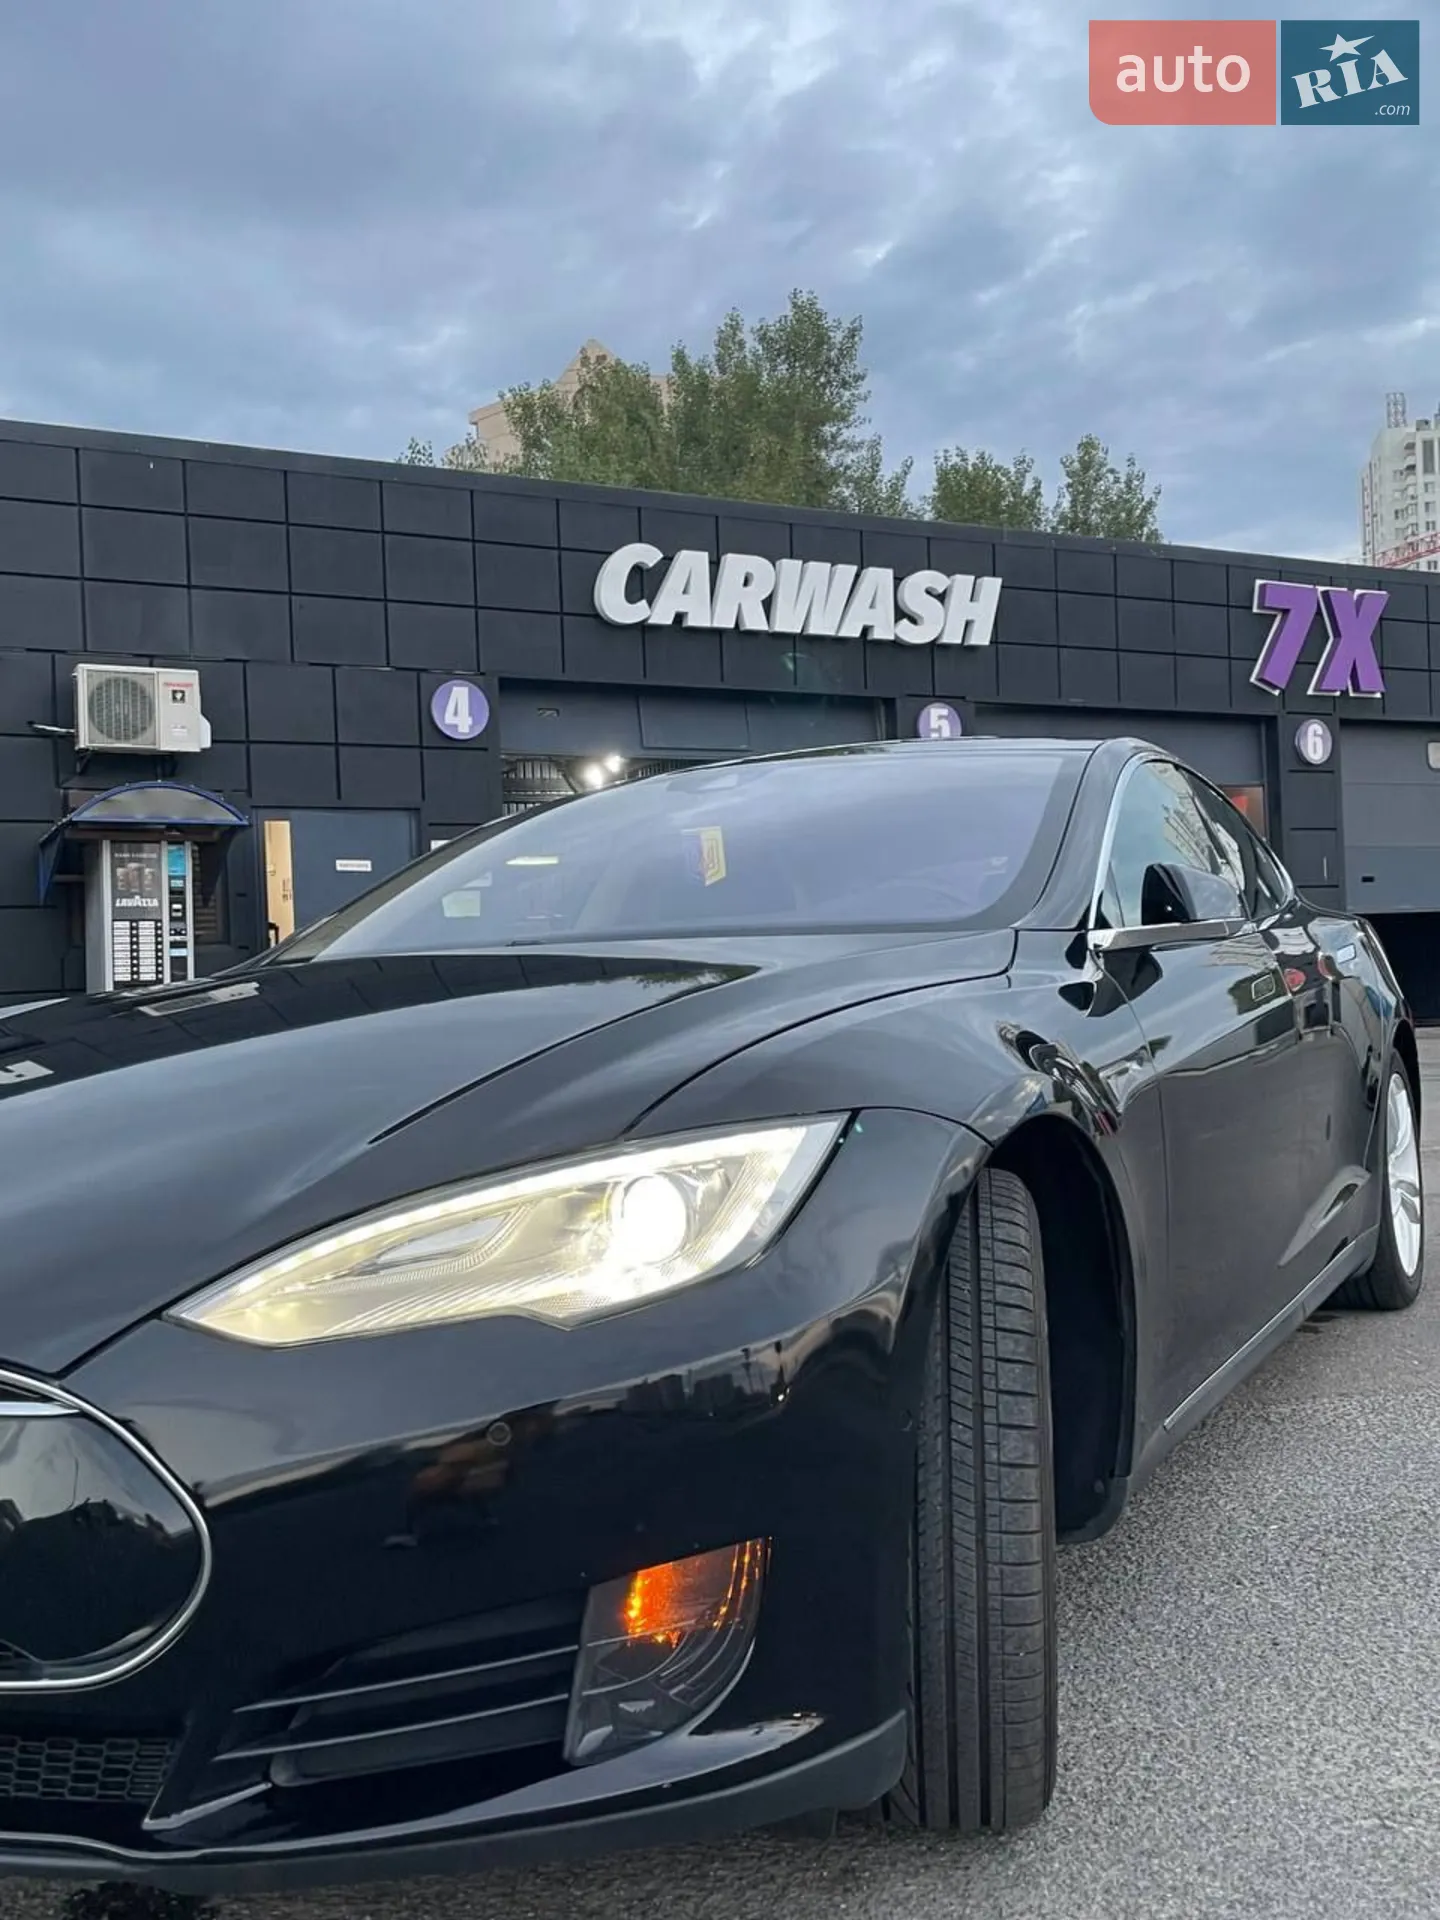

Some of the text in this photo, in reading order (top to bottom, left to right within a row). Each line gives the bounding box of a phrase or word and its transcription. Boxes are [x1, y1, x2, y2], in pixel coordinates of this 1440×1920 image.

[594, 542, 1003, 646] CARWASH
[1250, 579, 1391, 698] 7X
[444, 686, 473, 733] 4
[930, 707, 950, 738] 5
[1306, 722, 1324, 761] 6
